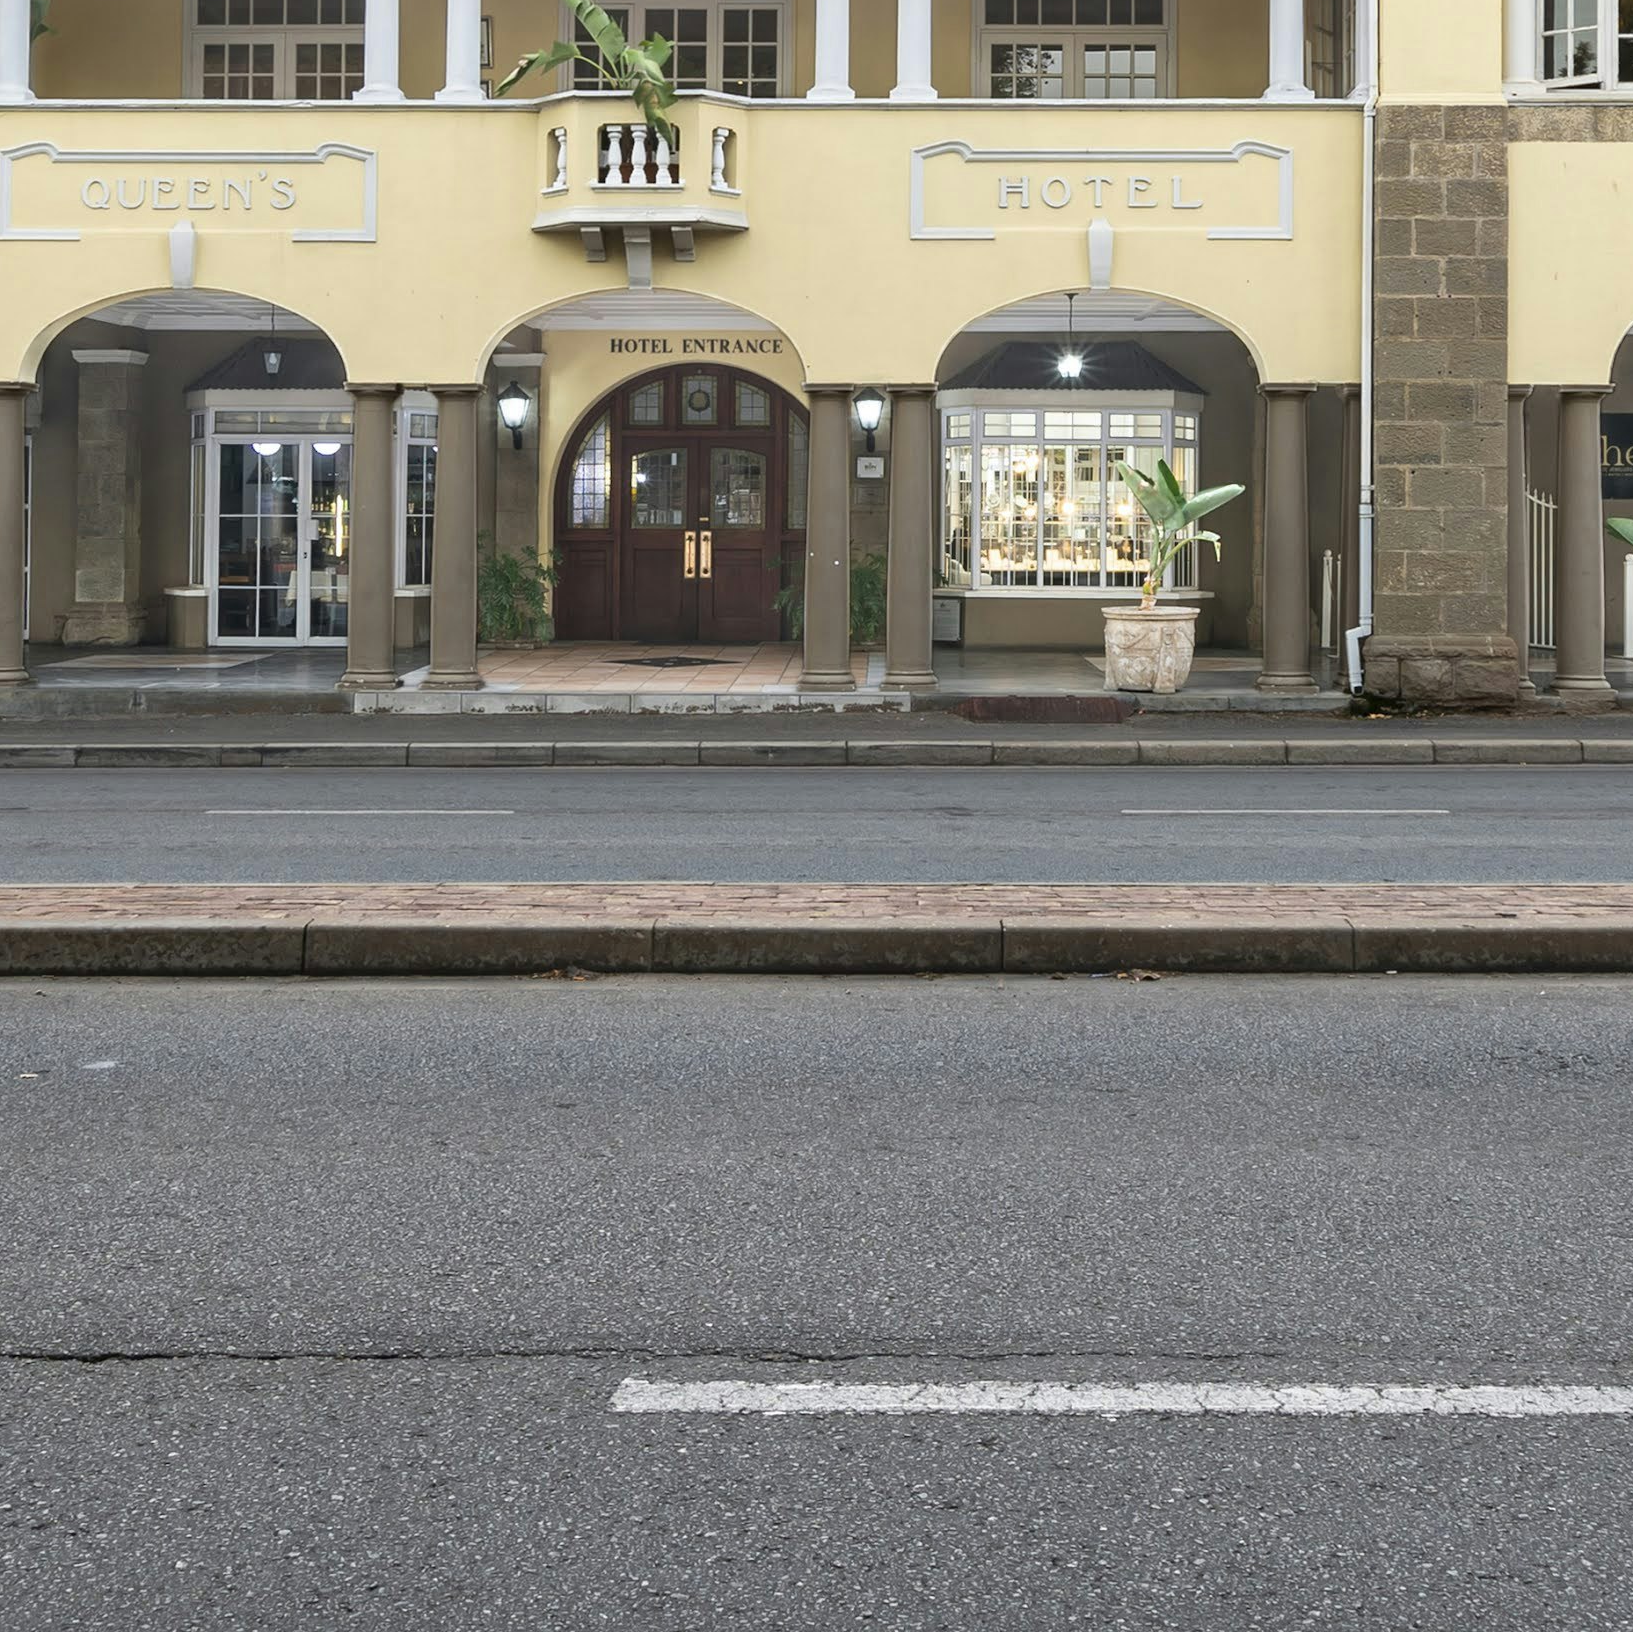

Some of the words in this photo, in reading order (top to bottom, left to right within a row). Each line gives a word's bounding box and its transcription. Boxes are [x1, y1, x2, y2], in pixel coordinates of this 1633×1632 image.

[81, 170, 296, 210] QUEEN'S
[998, 175, 1204, 209] HOTEL
[610, 338, 673, 354] HOTEL
[682, 338, 783, 354] ENTRANCE
